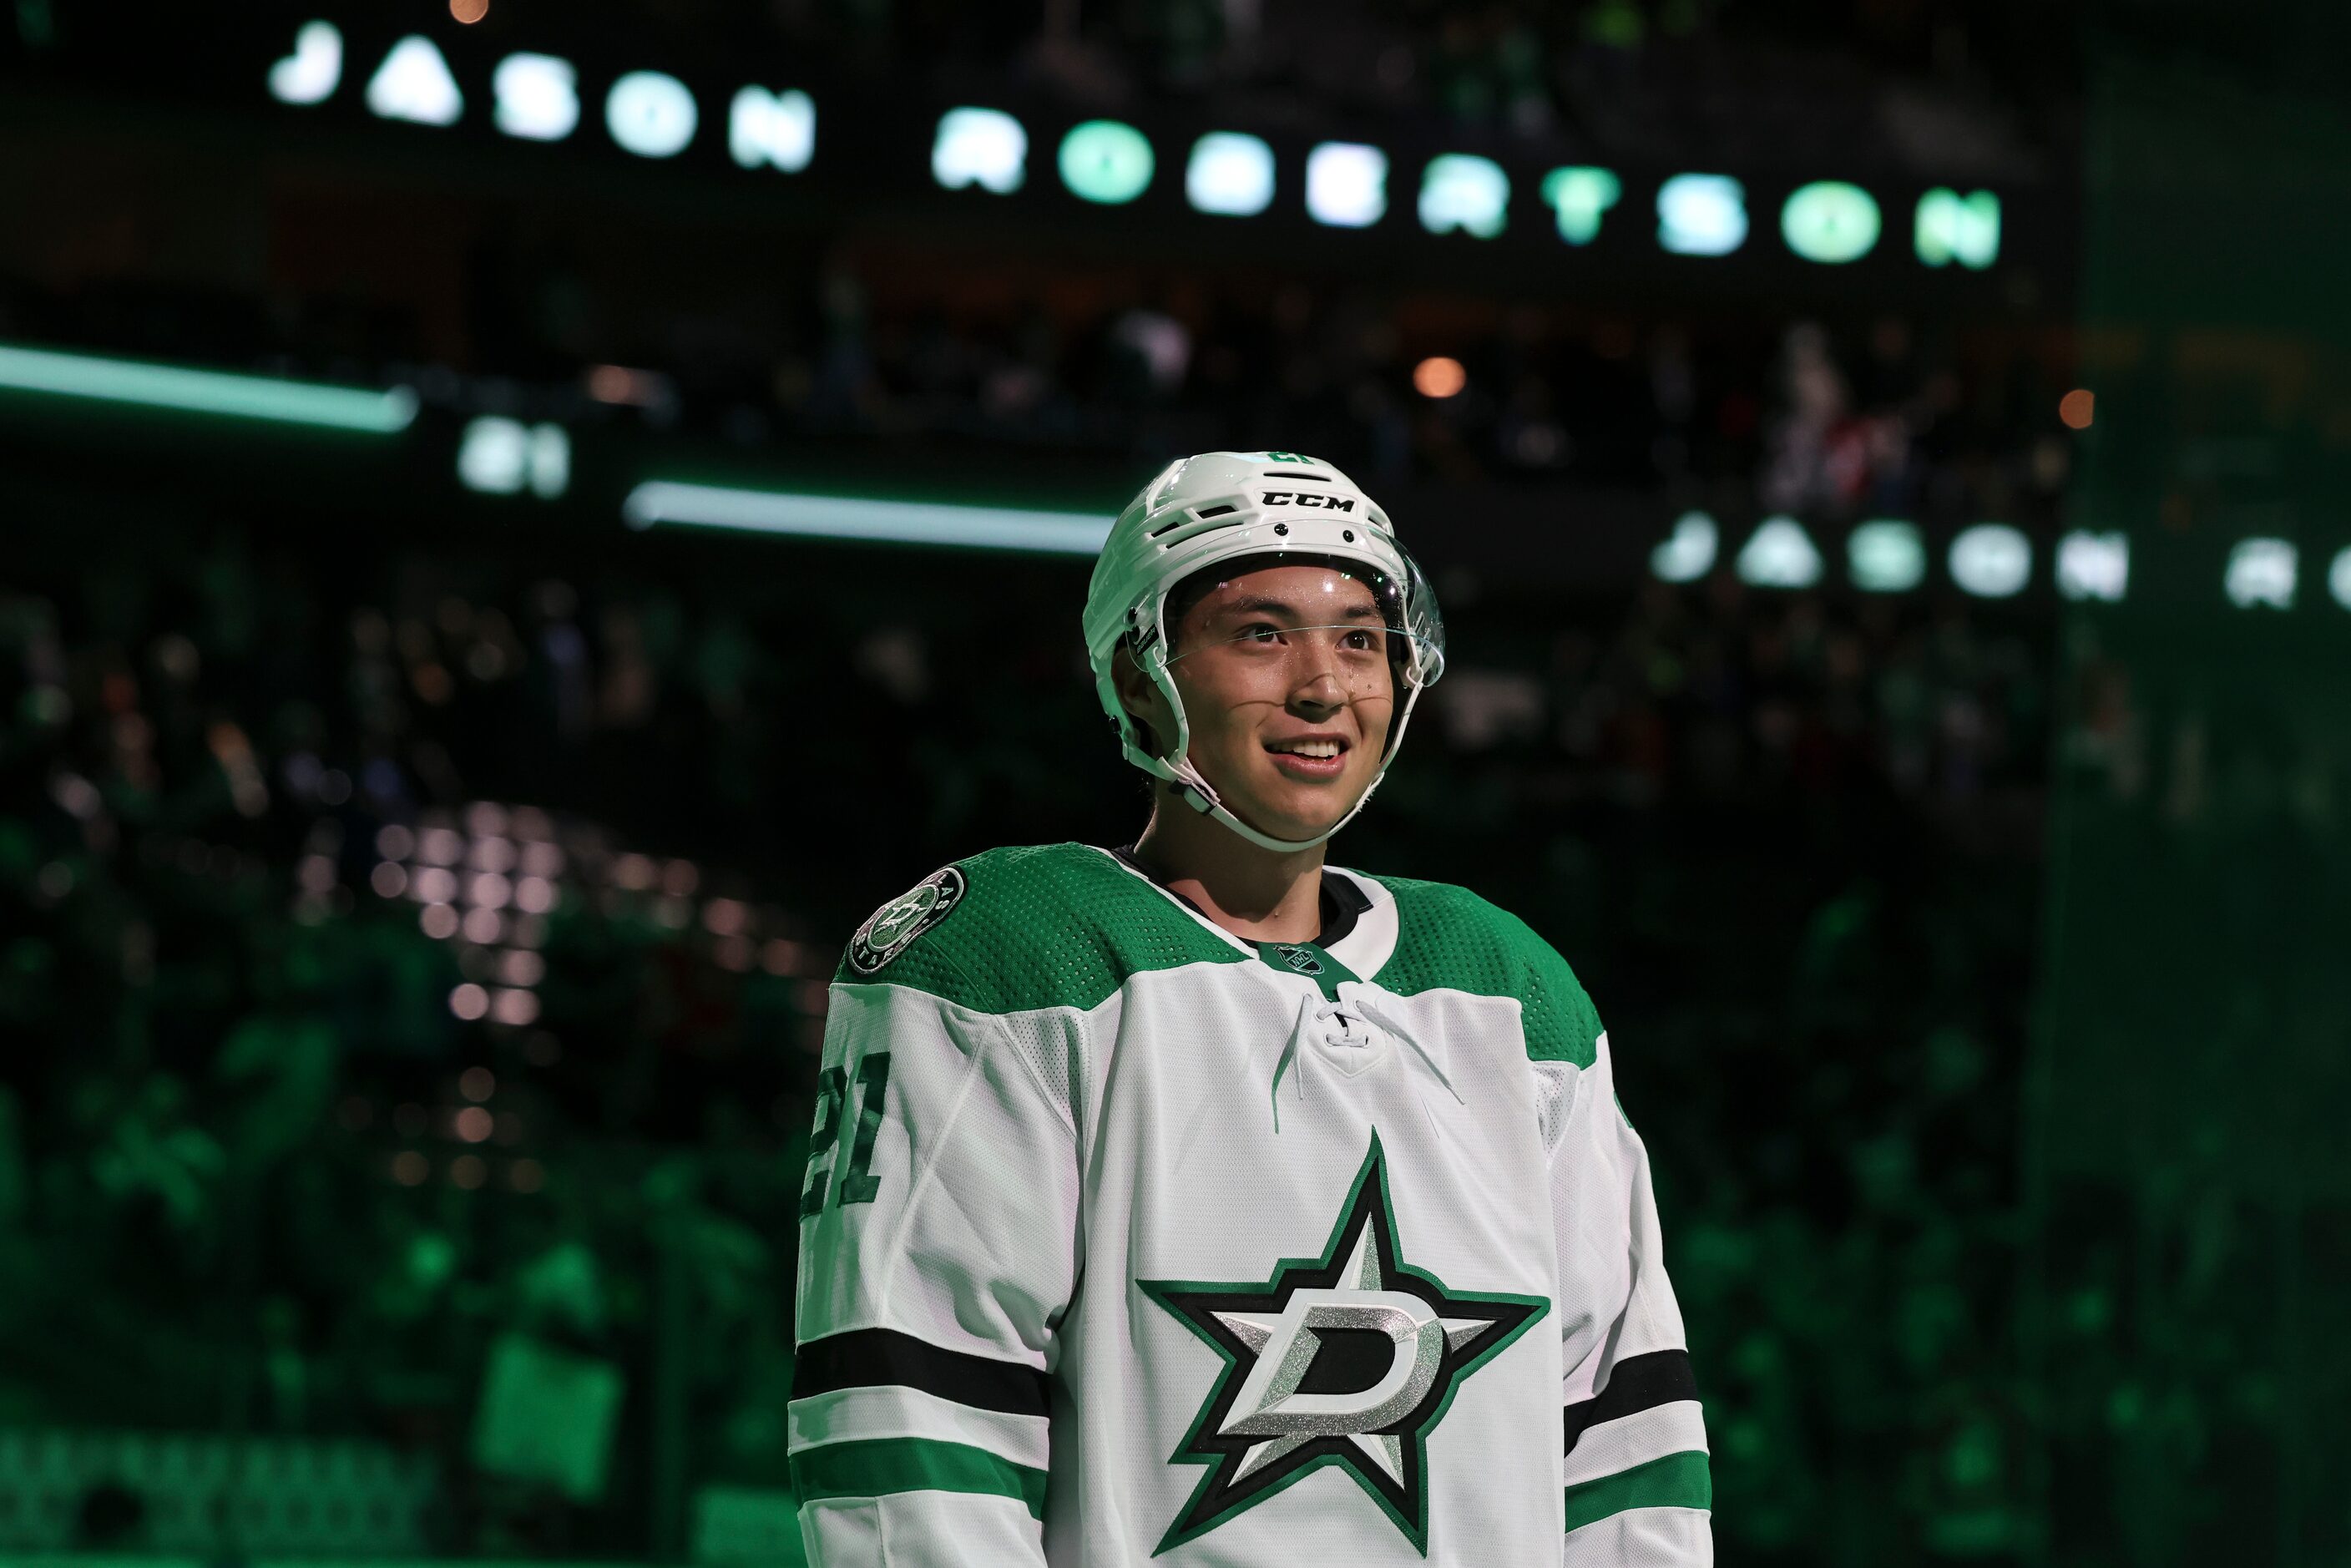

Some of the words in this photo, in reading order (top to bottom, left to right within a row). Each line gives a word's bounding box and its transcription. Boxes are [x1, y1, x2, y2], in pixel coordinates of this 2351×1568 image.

[270, 22, 816, 171] JASON
[1261, 491, 1355, 513] CCM
[1655, 515, 2130, 599] JASON
[2224, 538, 2351, 609] R
[1291, 952, 1310, 967] NHL
